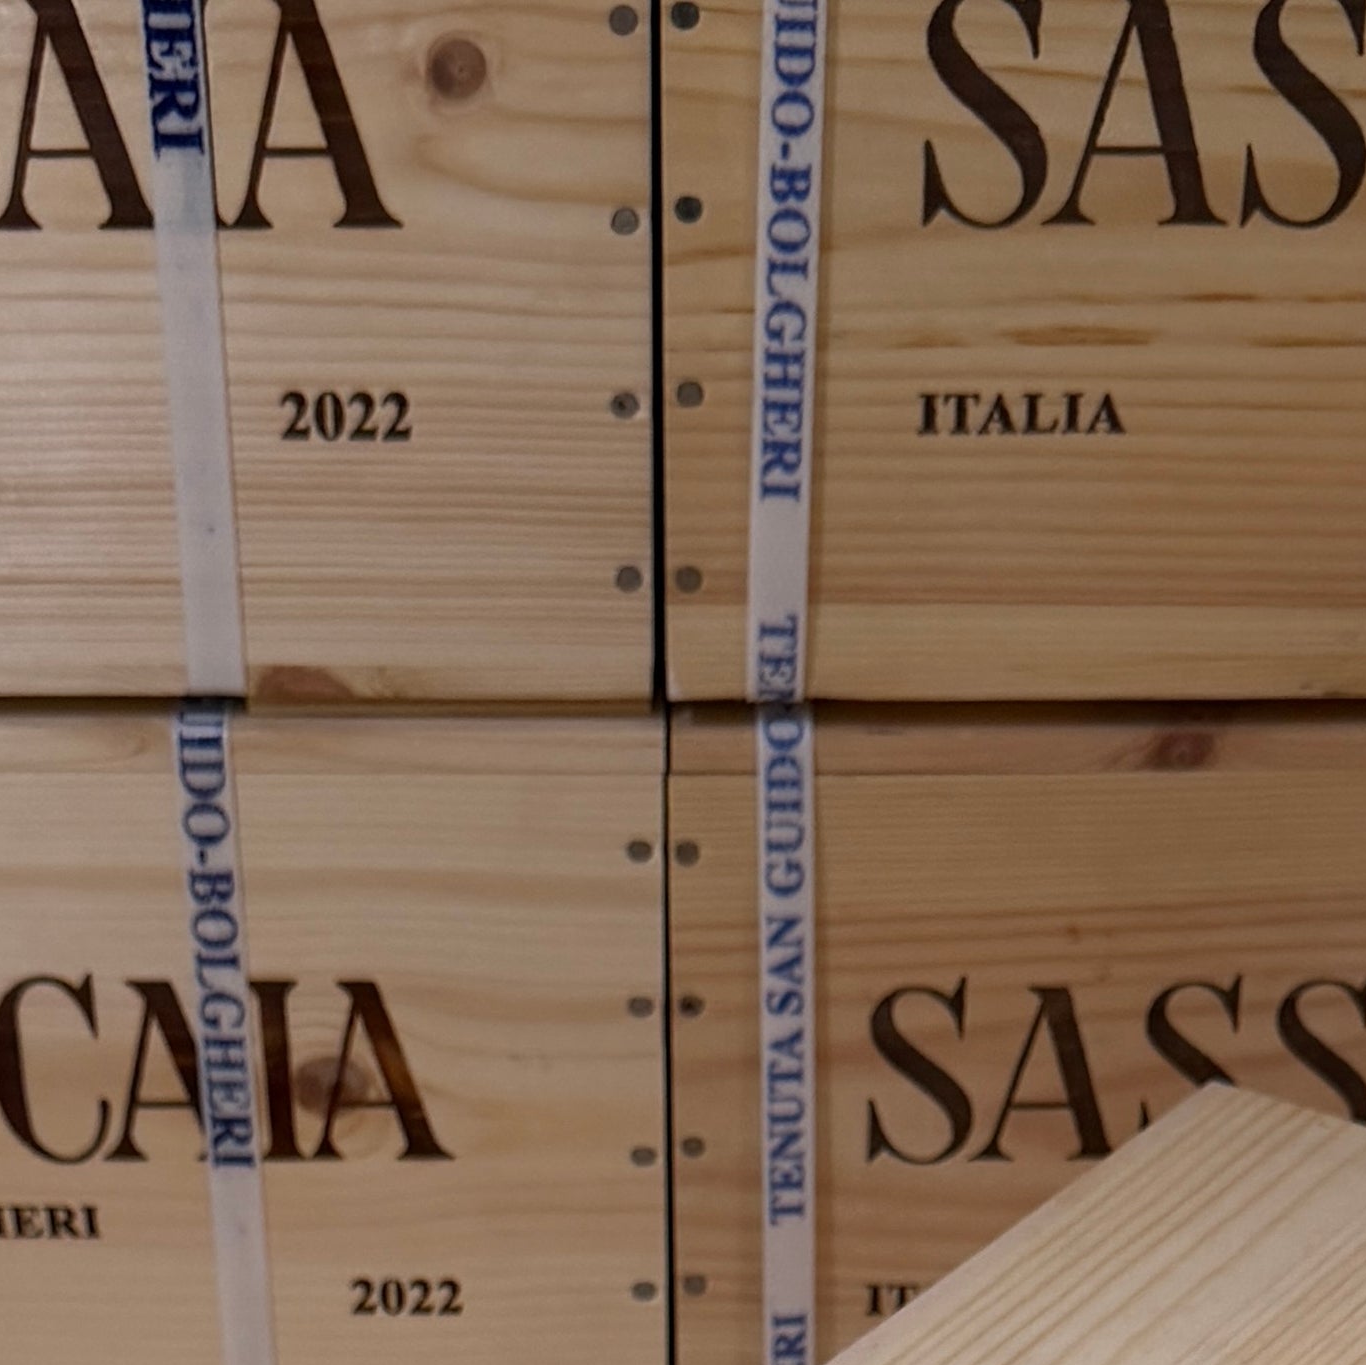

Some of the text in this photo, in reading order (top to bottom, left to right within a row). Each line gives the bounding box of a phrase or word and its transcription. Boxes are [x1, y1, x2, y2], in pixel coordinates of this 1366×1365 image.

[280, 391, 414, 442] 2022
[916, 392, 1126, 436] ITALIA
[765, 914, 807, 1022] SAN
[768, 1027, 807, 1227] TENUTA
[351, 1278, 464, 1318] 2022
